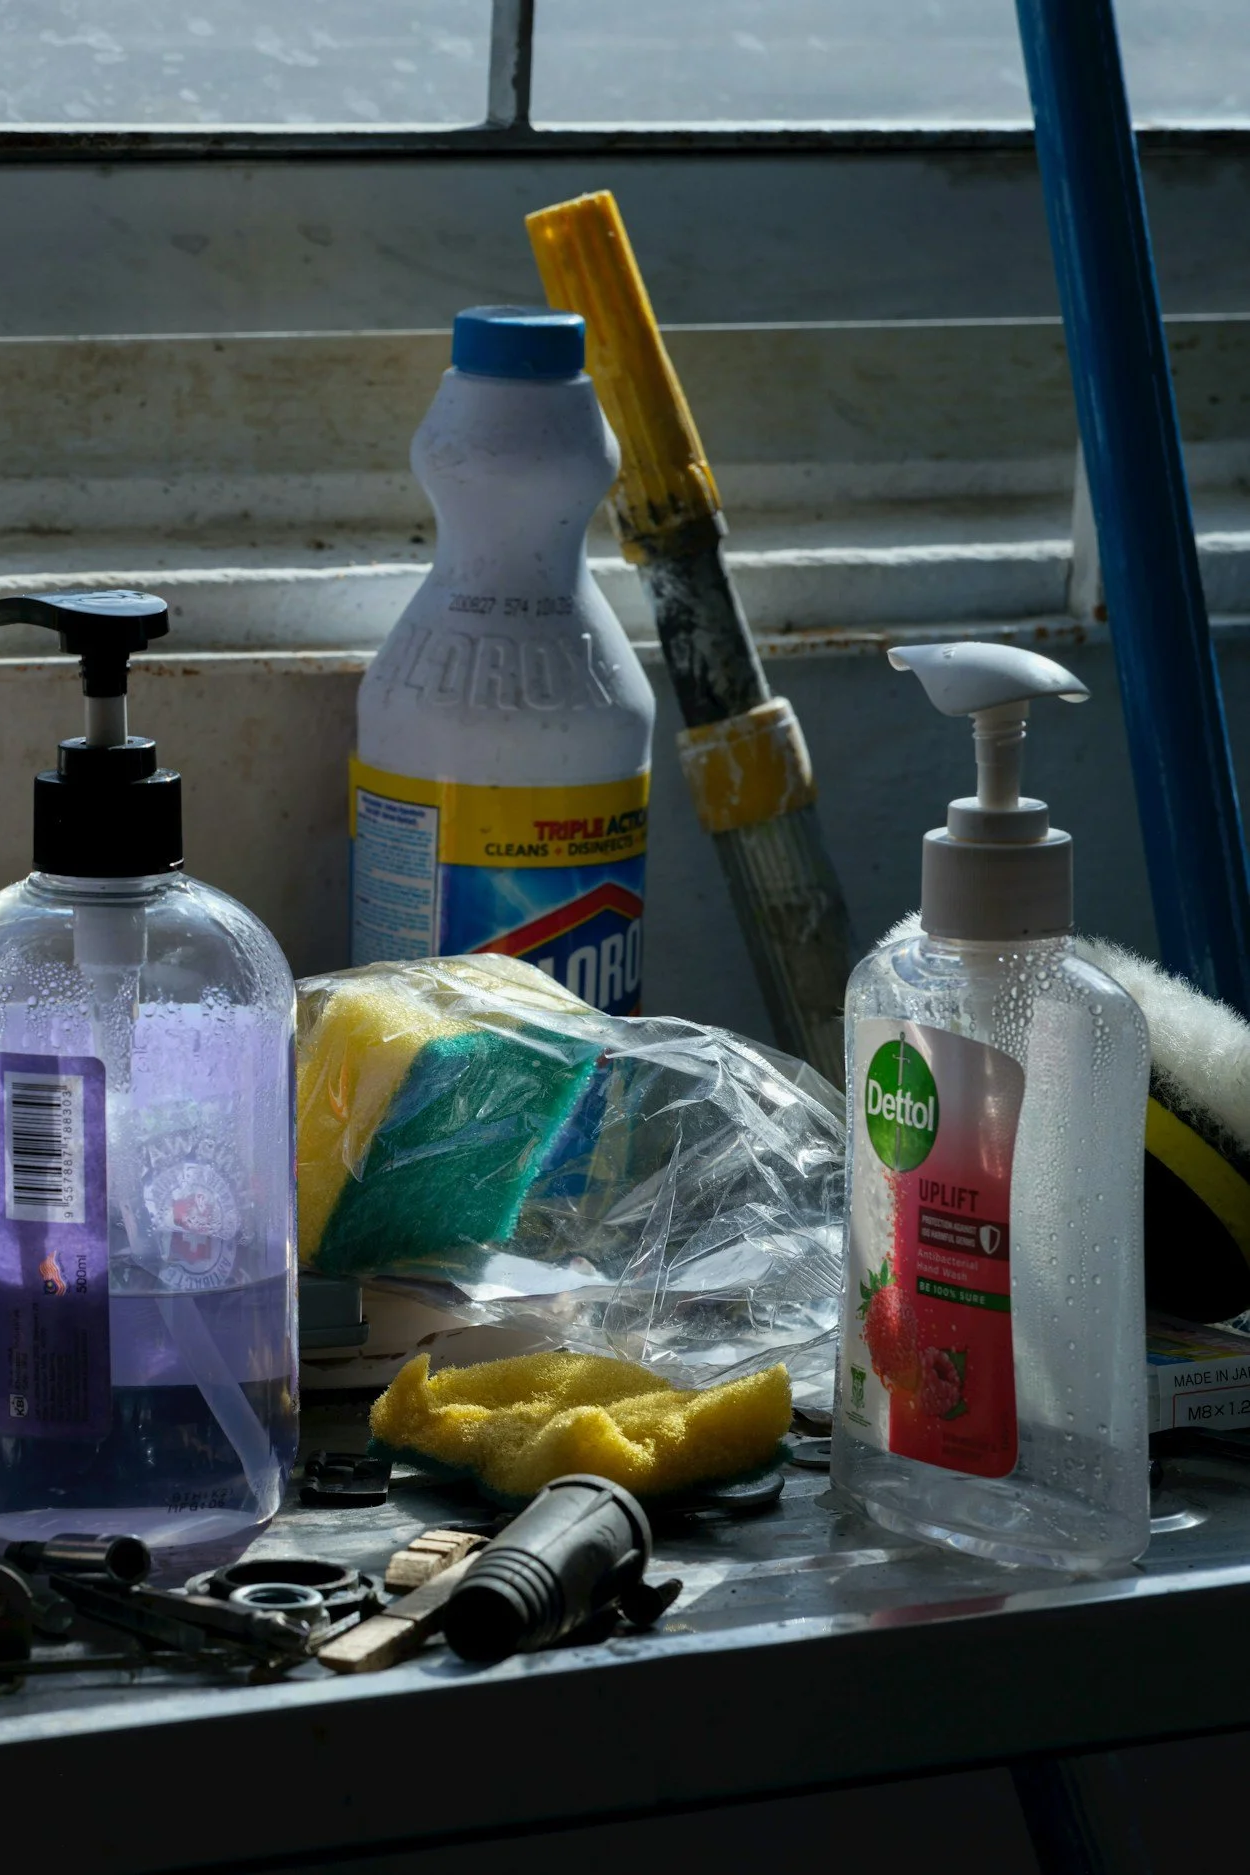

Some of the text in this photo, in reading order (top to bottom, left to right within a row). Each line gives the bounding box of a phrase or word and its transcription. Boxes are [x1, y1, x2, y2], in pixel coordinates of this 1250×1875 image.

[534, 818, 604, 842] TRIPLE
[484, 836, 634, 858] CLEANS DISINFECTS
[62, 1090, 72, 1140] 188303
[867, 1081, 935, 1133] Dettol
[62, 1151, 73, 1201] 557887
[918, 1178, 979, 1212] UPLIFT
[917, 1262, 968, 1281] Hand Wash
[918, 1249, 979, 1271] Antibacterial
[76, 1254, 87, 1294] 500ml
[919, 1281, 987, 1304] BE 100% SURE
[1174, 1366, 1250, 1387] MADE IN JA
